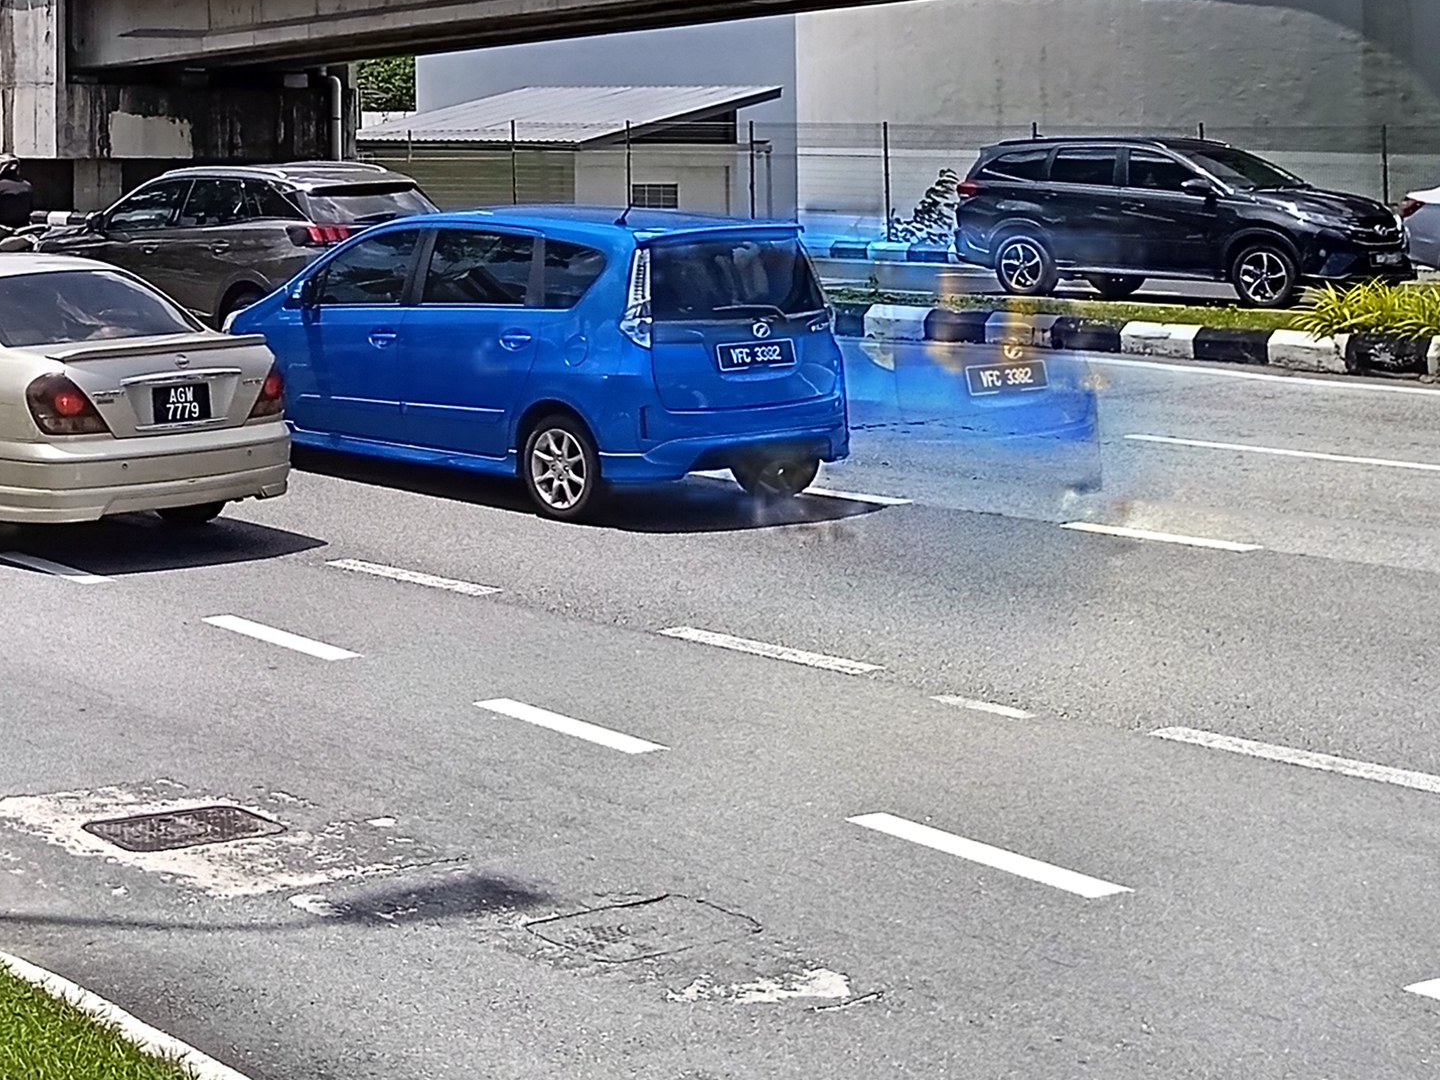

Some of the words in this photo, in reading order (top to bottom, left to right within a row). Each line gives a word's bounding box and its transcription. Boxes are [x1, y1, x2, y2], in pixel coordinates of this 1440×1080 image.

[730, 348, 752, 364] VFC
[980, 370, 1002, 388] VFC
[169, 386, 194, 403] AGW
[166, 401, 200, 420] 7779
